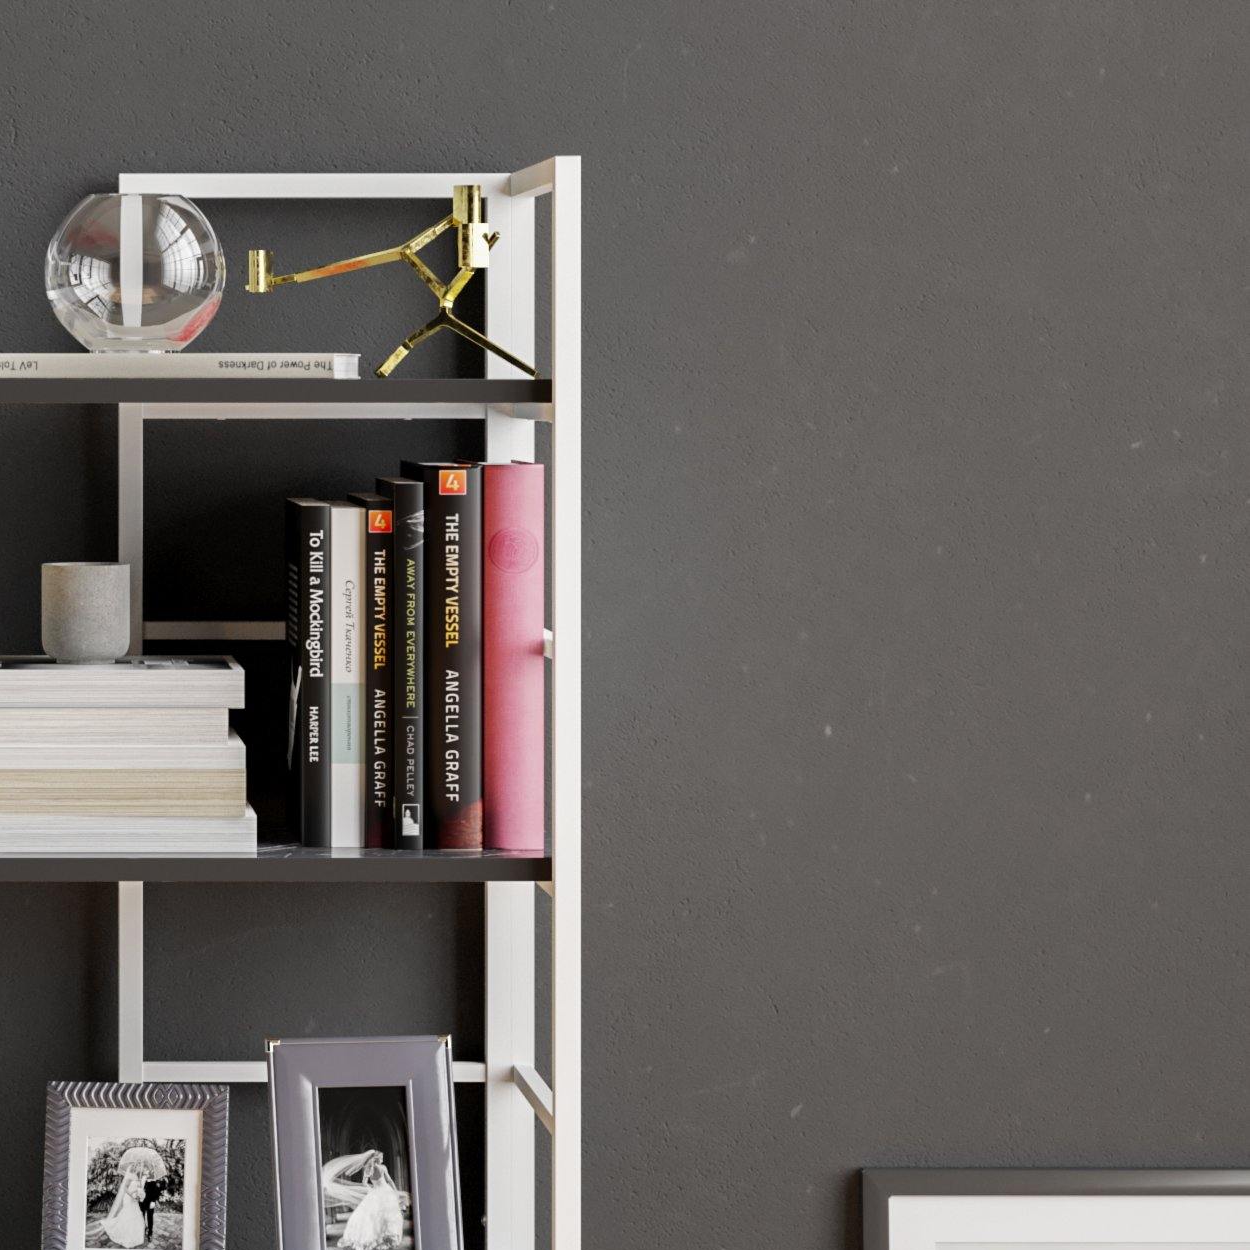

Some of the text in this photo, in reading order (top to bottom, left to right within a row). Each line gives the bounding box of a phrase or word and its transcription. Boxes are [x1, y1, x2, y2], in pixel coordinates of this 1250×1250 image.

[218, 360, 334, 370] The Power of Darkness
[374, 514, 386, 529] 4
[446, 474, 460, 491] 4
[310, 530, 324, 548] To
[310, 552, 324, 572] Kill
[374, 549, 386, 670] THE EMPTY VESSEL
[446, 513, 459, 648] THE EMPTY VESSEL
[306, 589, 324, 678] Mockingbird
[342, 580, 355, 673] Сергей Ткаченко
[406, 558, 416, 708] AWAY FROM EVERYWHERE
[310, 706, 318, 762] HARPER LEE
[374, 689, 386, 808] ANGELLA GRAFF
[406, 726, 414, 797] CHAD PELLEY
[446, 670, 460, 802] ANGELLA GRAFF
